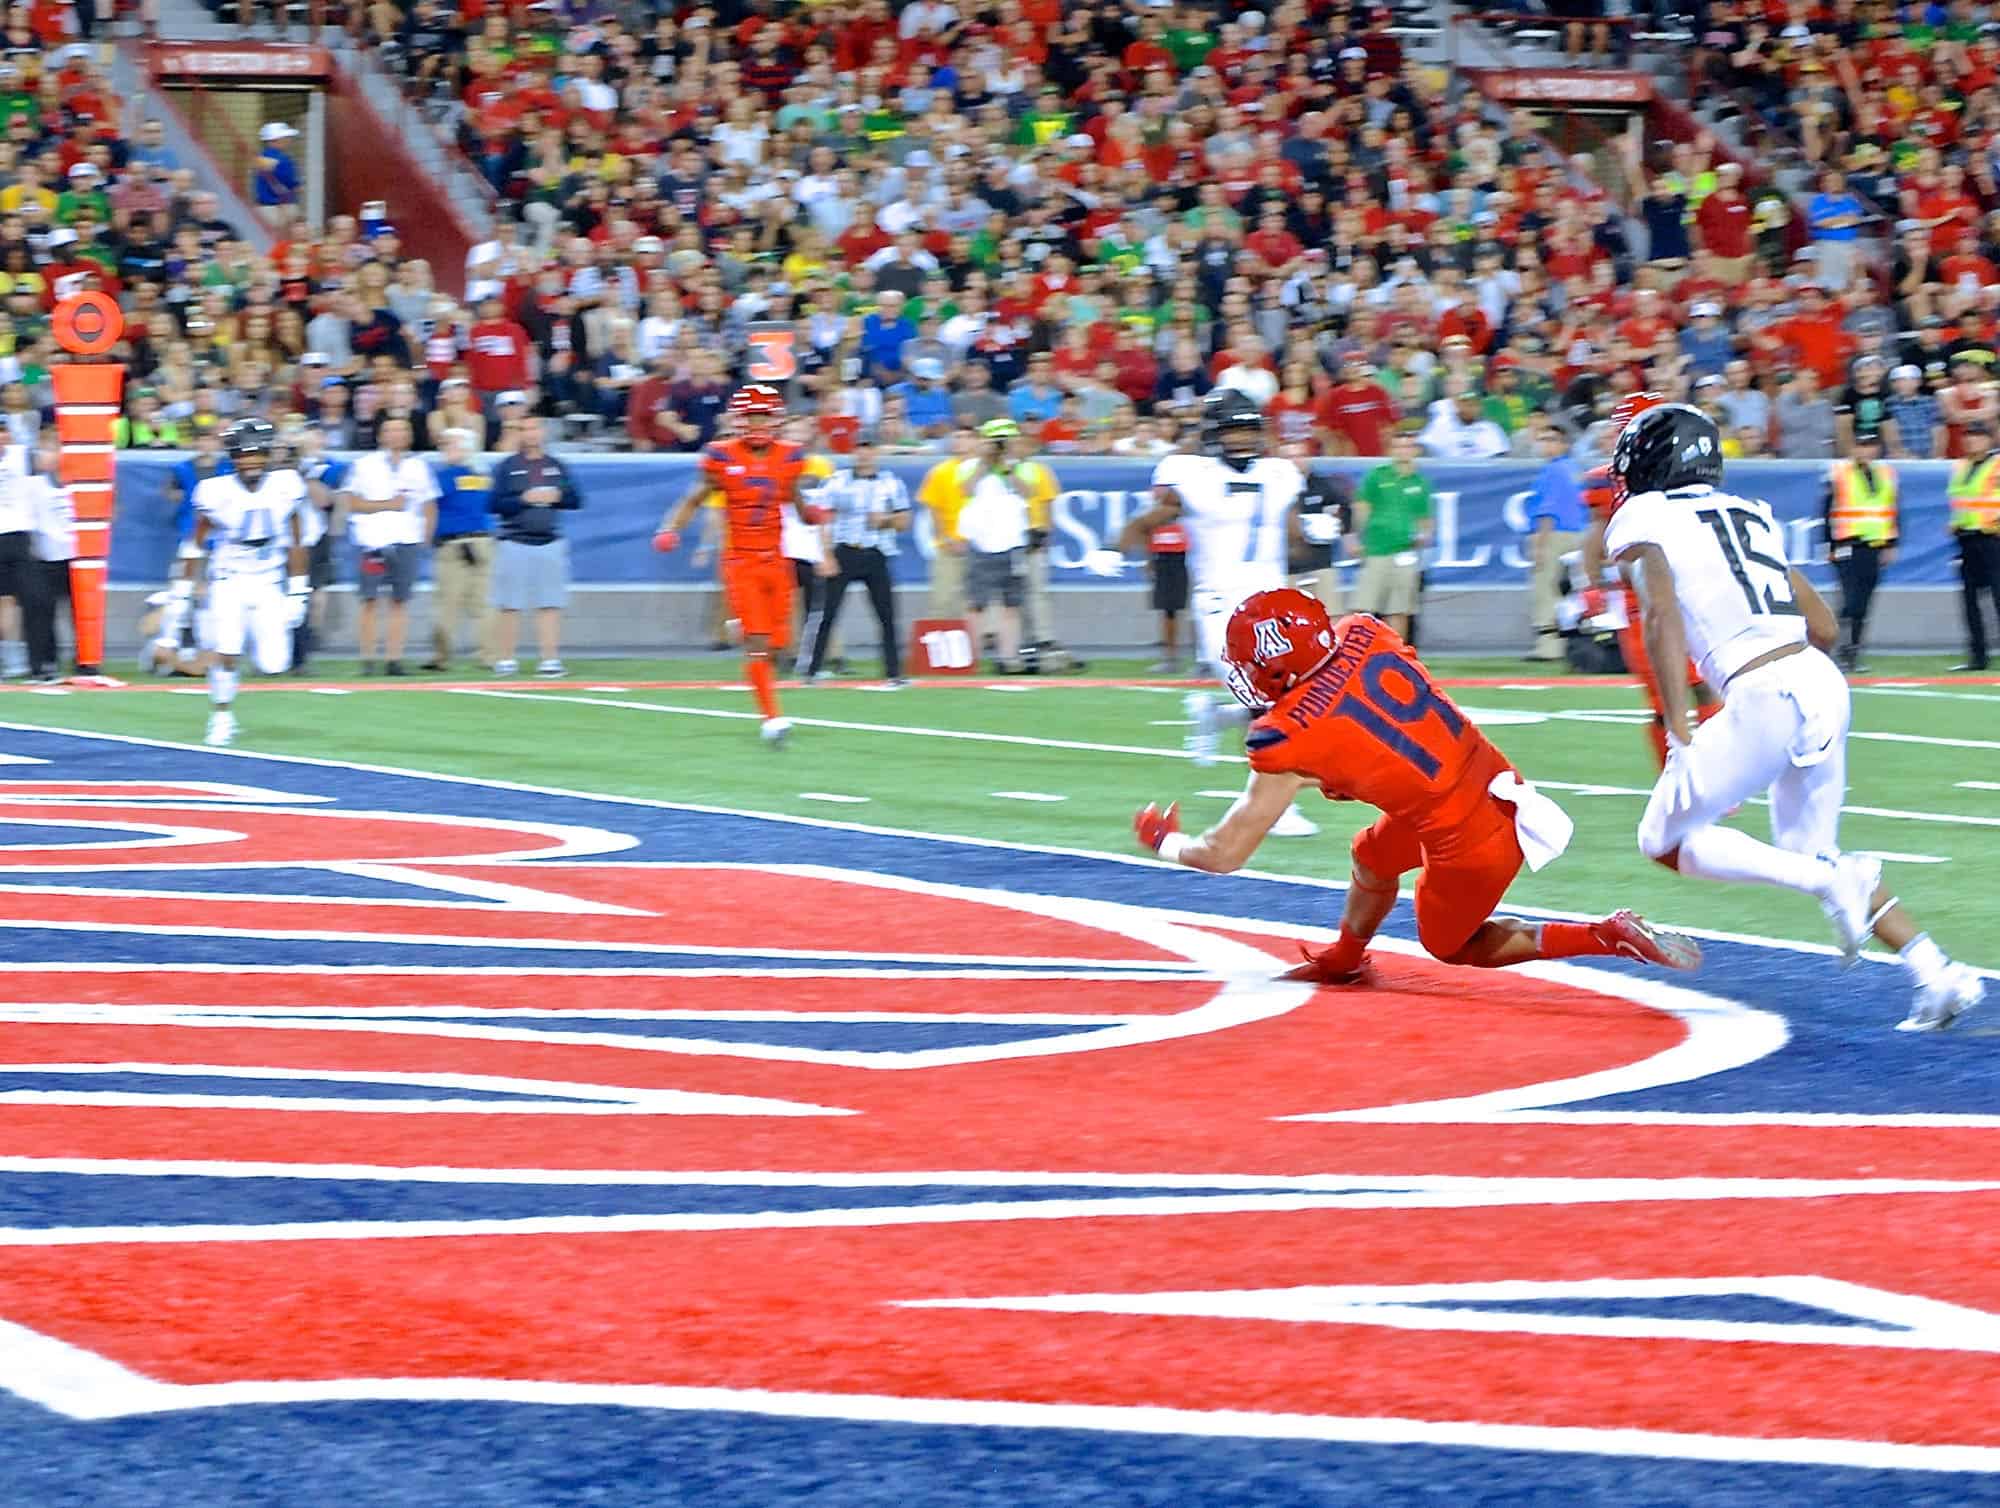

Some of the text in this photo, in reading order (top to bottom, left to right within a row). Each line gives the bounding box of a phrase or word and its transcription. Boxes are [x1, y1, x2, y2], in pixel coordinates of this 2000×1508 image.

[748, 331, 796, 380] 3
[1223, 482, 1265, 562] 7
[1695, 507, 1803, 615] 15
[1287, 624, 1377, 729] POINDEXTER
[1333, 651, 1464, 782] 19
